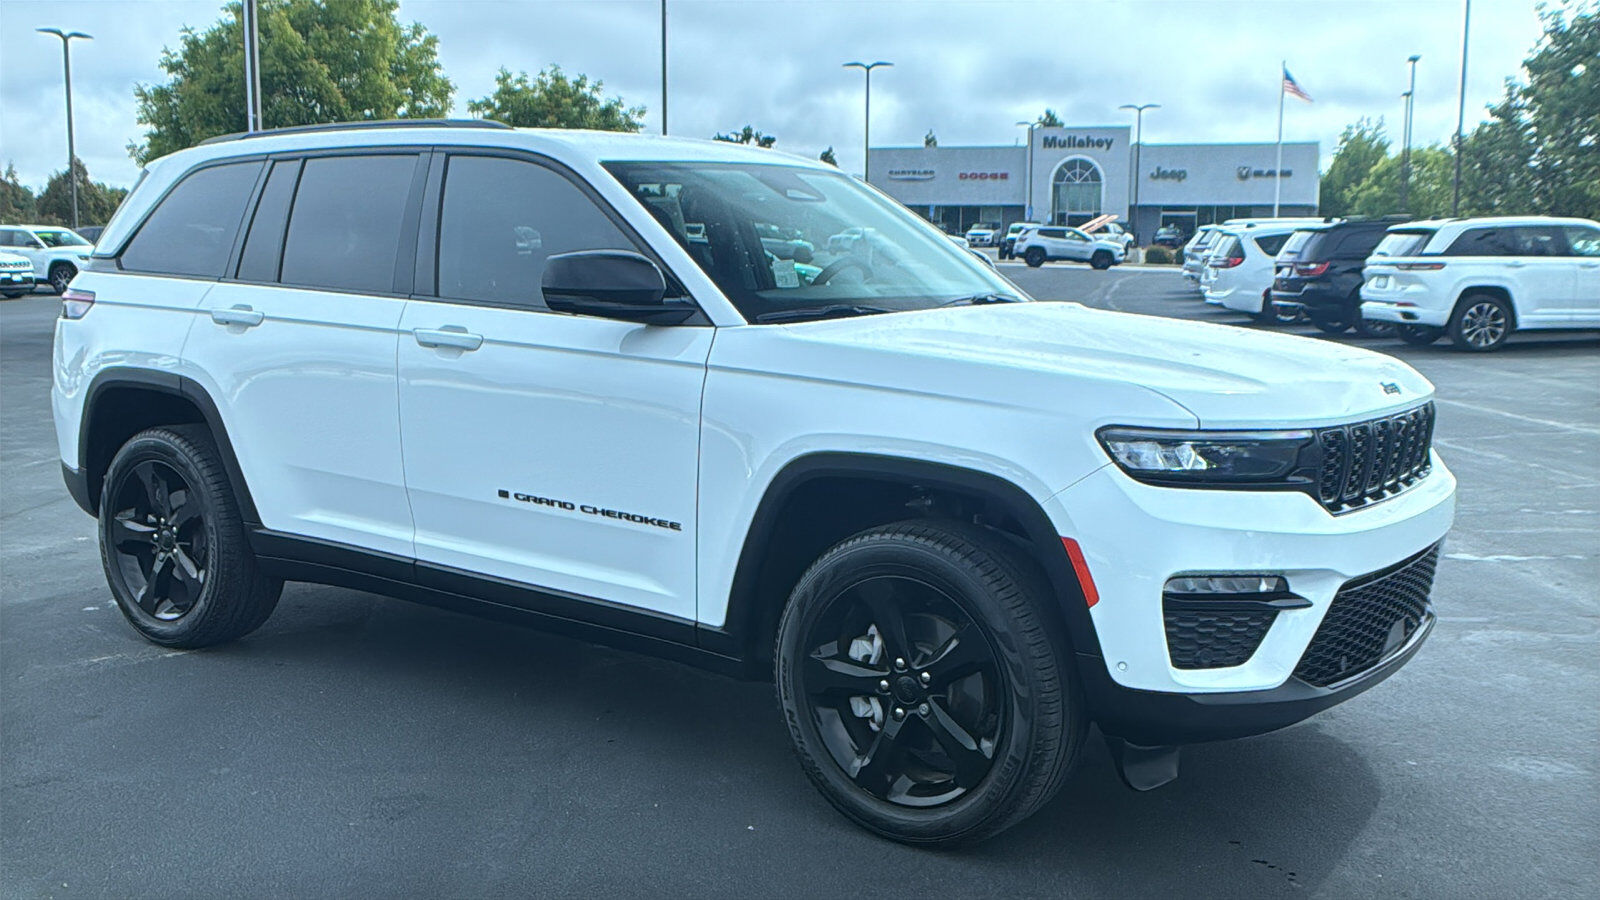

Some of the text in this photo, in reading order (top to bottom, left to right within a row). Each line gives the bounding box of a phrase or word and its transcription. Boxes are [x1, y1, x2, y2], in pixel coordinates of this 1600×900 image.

[1042, 135, 1114, 151] Mullahey
[958, 171, 1009, 180] DODGE
[1149, 165, 1187, 182] Jeep
[514, 492, 682, 531] GRAND CHEROKEE
